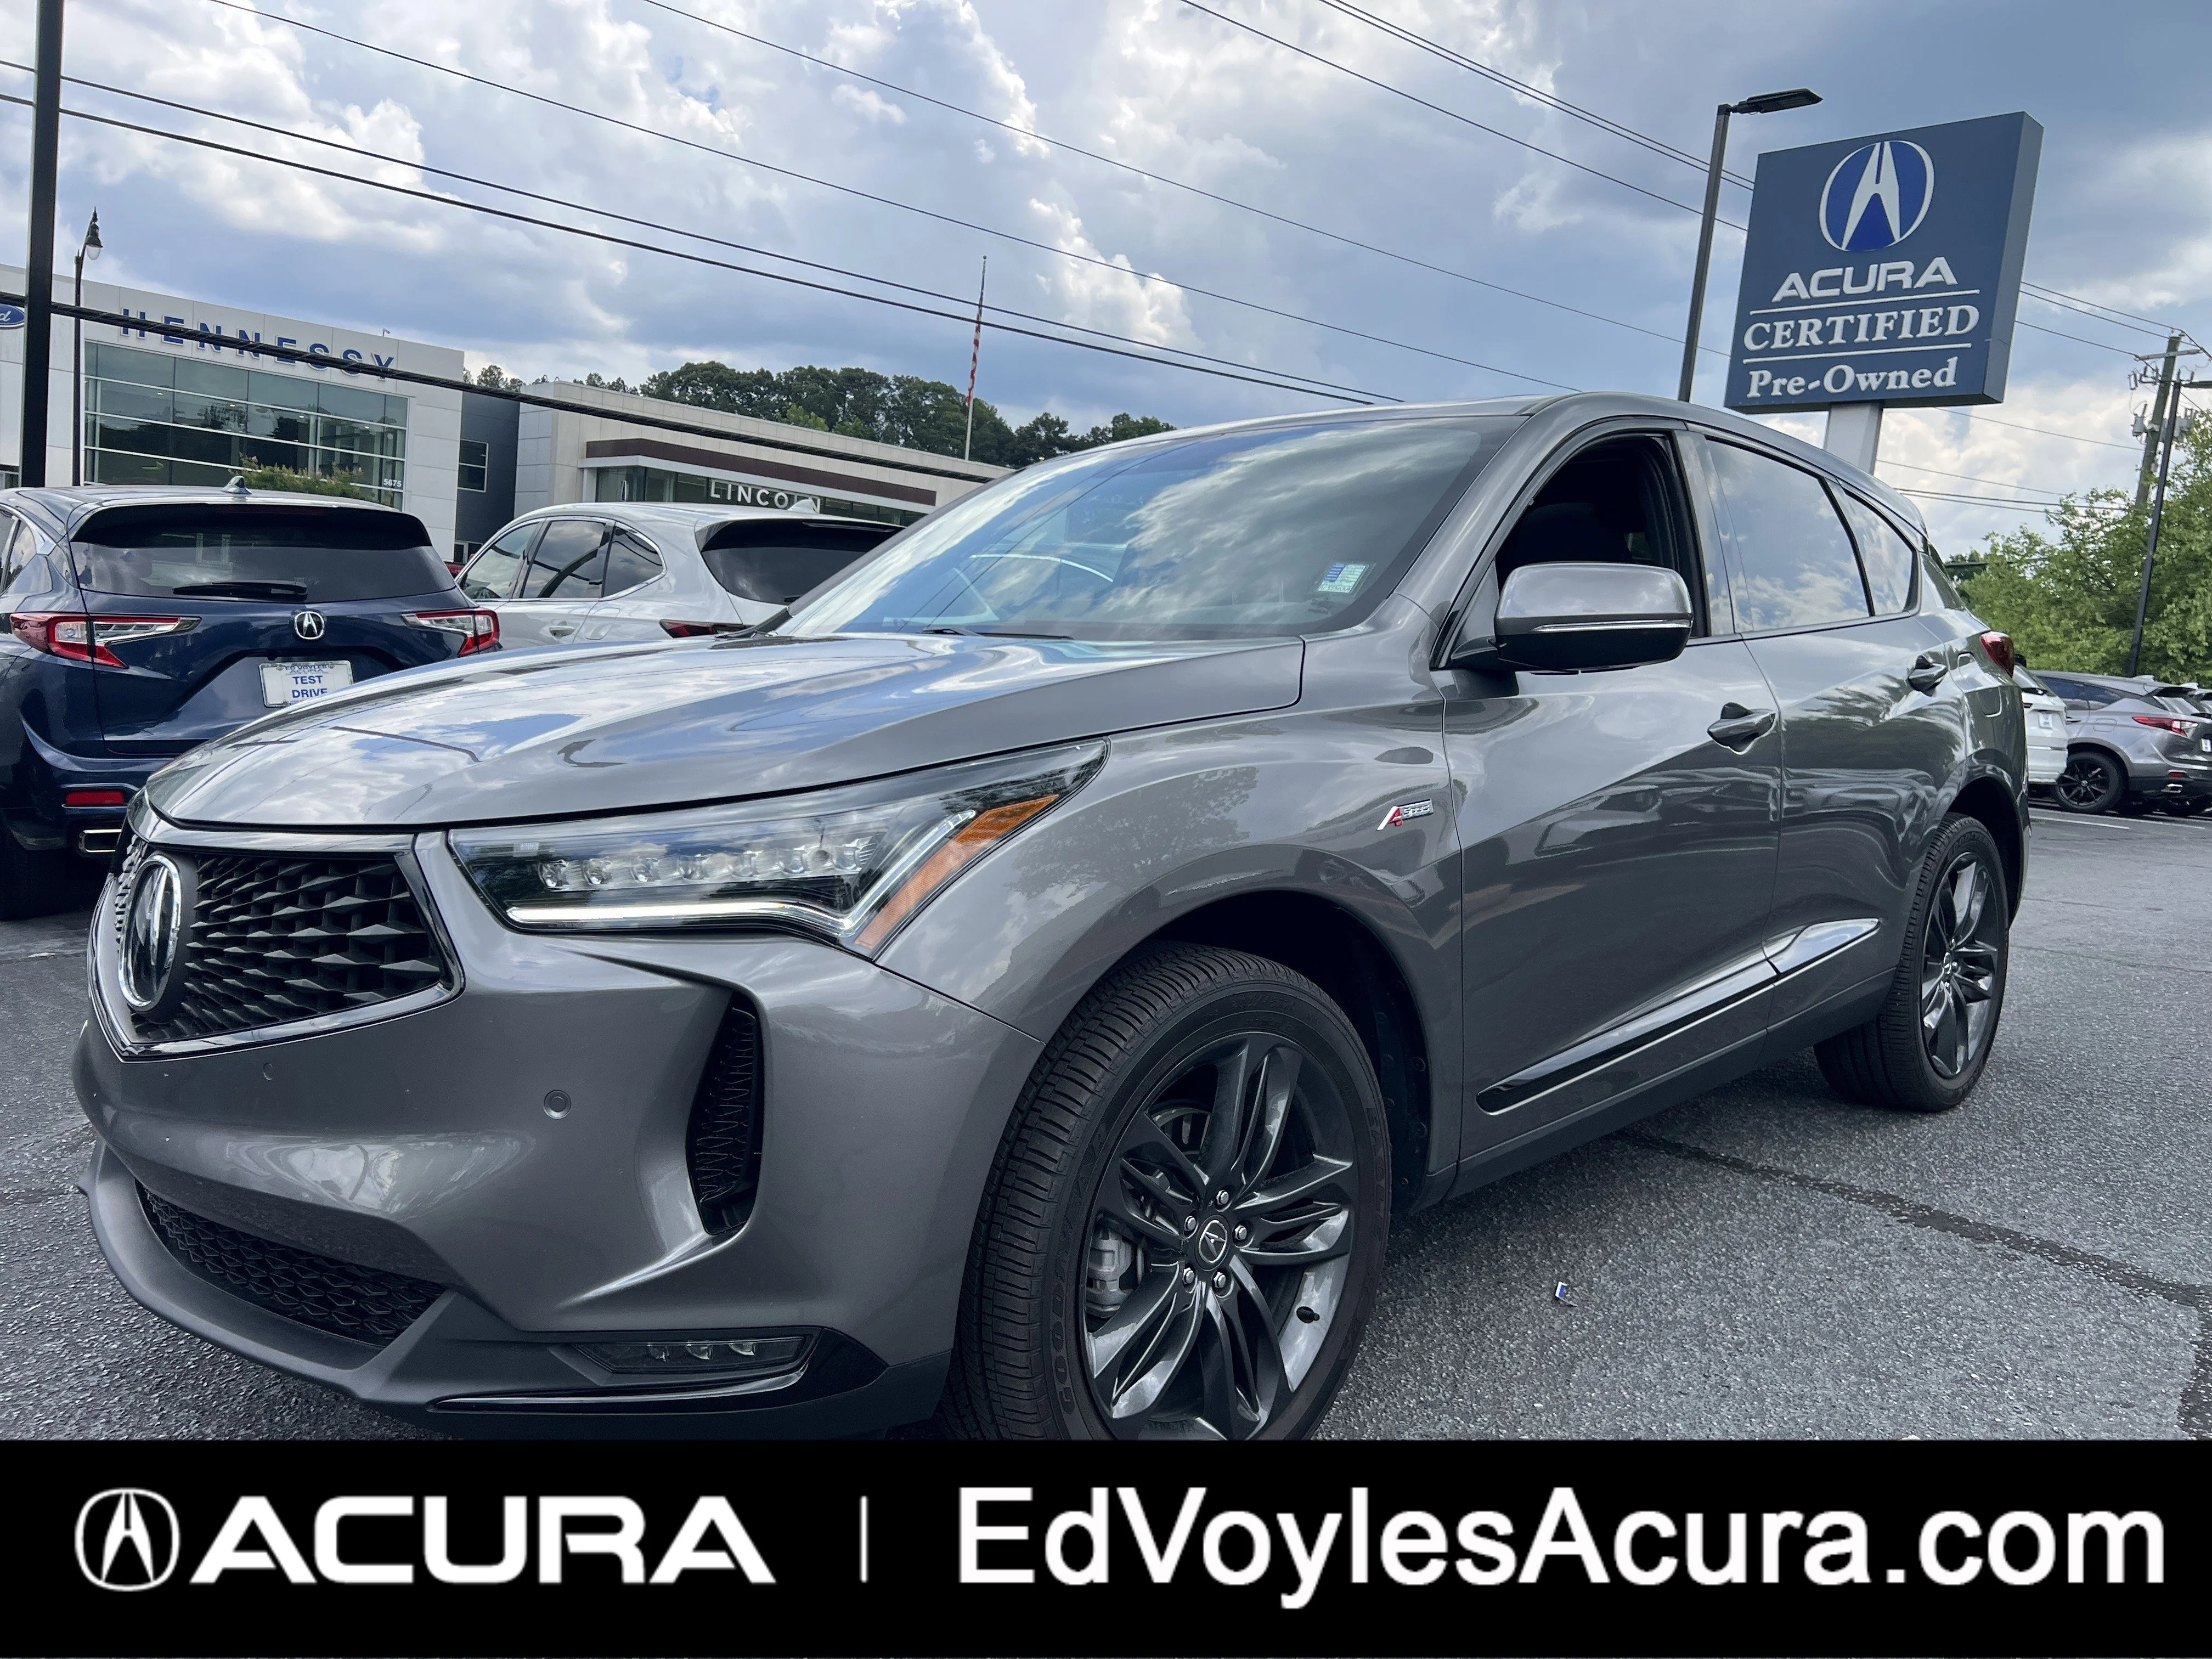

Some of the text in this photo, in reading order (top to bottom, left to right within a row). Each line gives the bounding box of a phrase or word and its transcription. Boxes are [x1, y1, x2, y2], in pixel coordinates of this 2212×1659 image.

[1771, 256, 1958, 303] ACURA
[121, 308, 394, 381] HENNESSY
[1743, 304, 1980, 351] CERTIFIED
[1746, 356, 1959, 399] Pre-Owned
[383, 478, 402, 488] 5675
[292, 675, 323, 685] TEST
[292, 688, 328, 698] DRIVE
